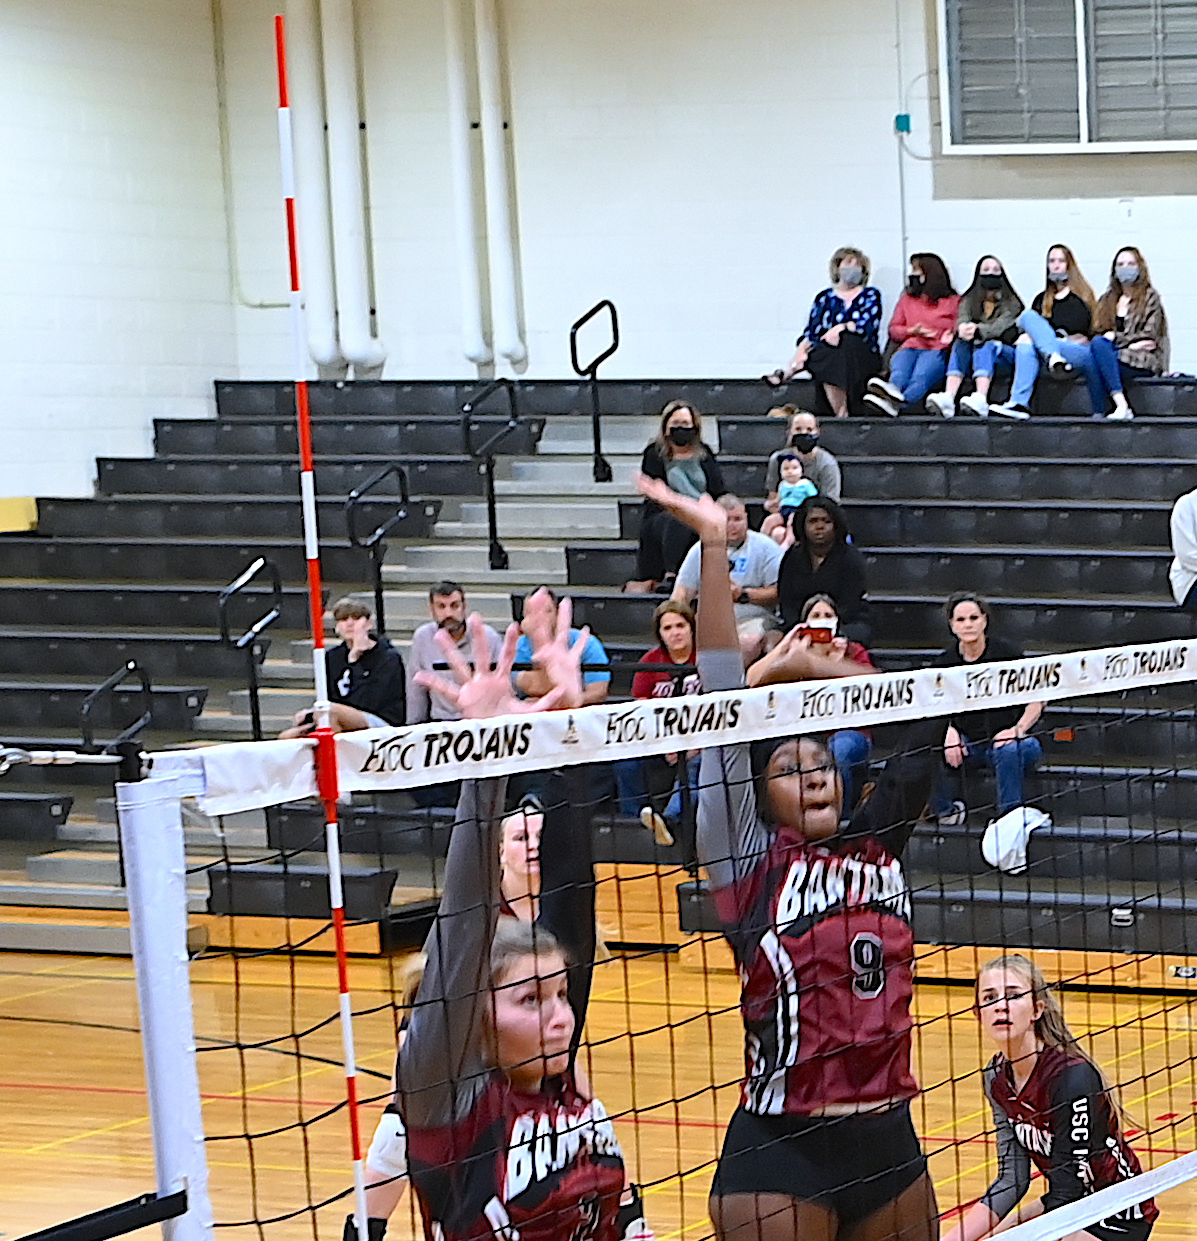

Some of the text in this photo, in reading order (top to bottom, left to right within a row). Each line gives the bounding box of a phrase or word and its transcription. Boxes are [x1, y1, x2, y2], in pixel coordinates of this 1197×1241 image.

[999, 662, 1062, 693] TROJANS
[1133, 646, 1188, 675] TROJANS
[841, 678, 915, 713] TROJANS
[653, 699, 743, 738] TROJANS
[423, 722, 532, 768] TROJANS
[850, 931, 885, 1000] 9
[1071, 1098, 1089, 1141] USC
